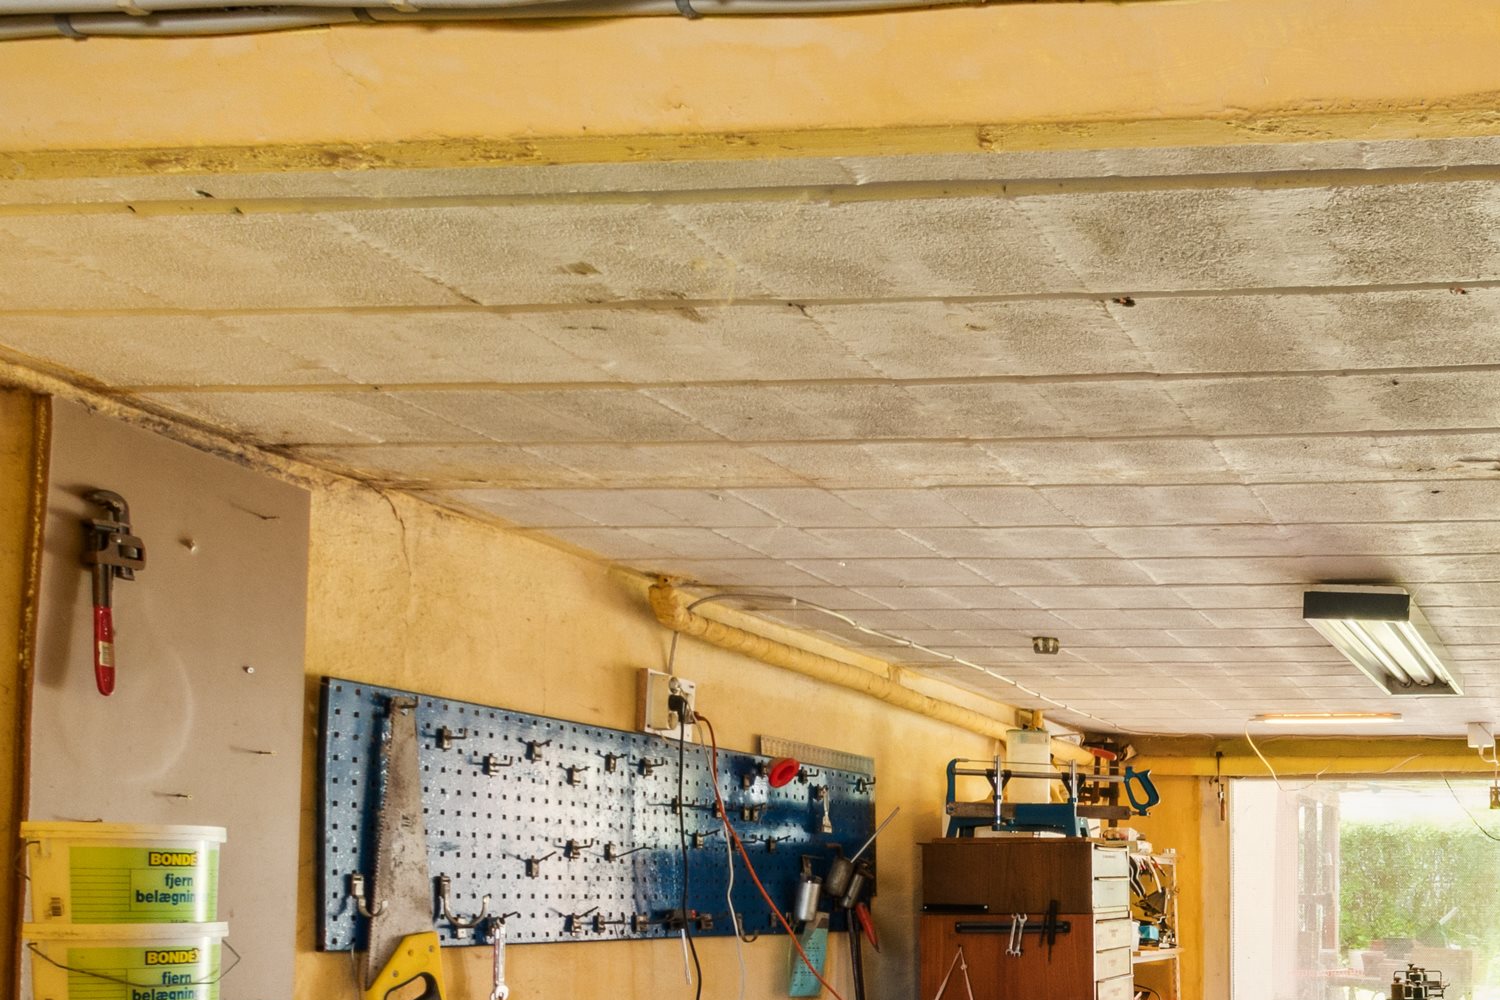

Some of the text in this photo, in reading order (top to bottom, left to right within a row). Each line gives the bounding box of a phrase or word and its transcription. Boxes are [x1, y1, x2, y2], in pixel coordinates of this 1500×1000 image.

[149, 852, 199, 866] BONDE
[165, 873, 193, 889] fjern
[136, 890, 195, 905] belægnin
